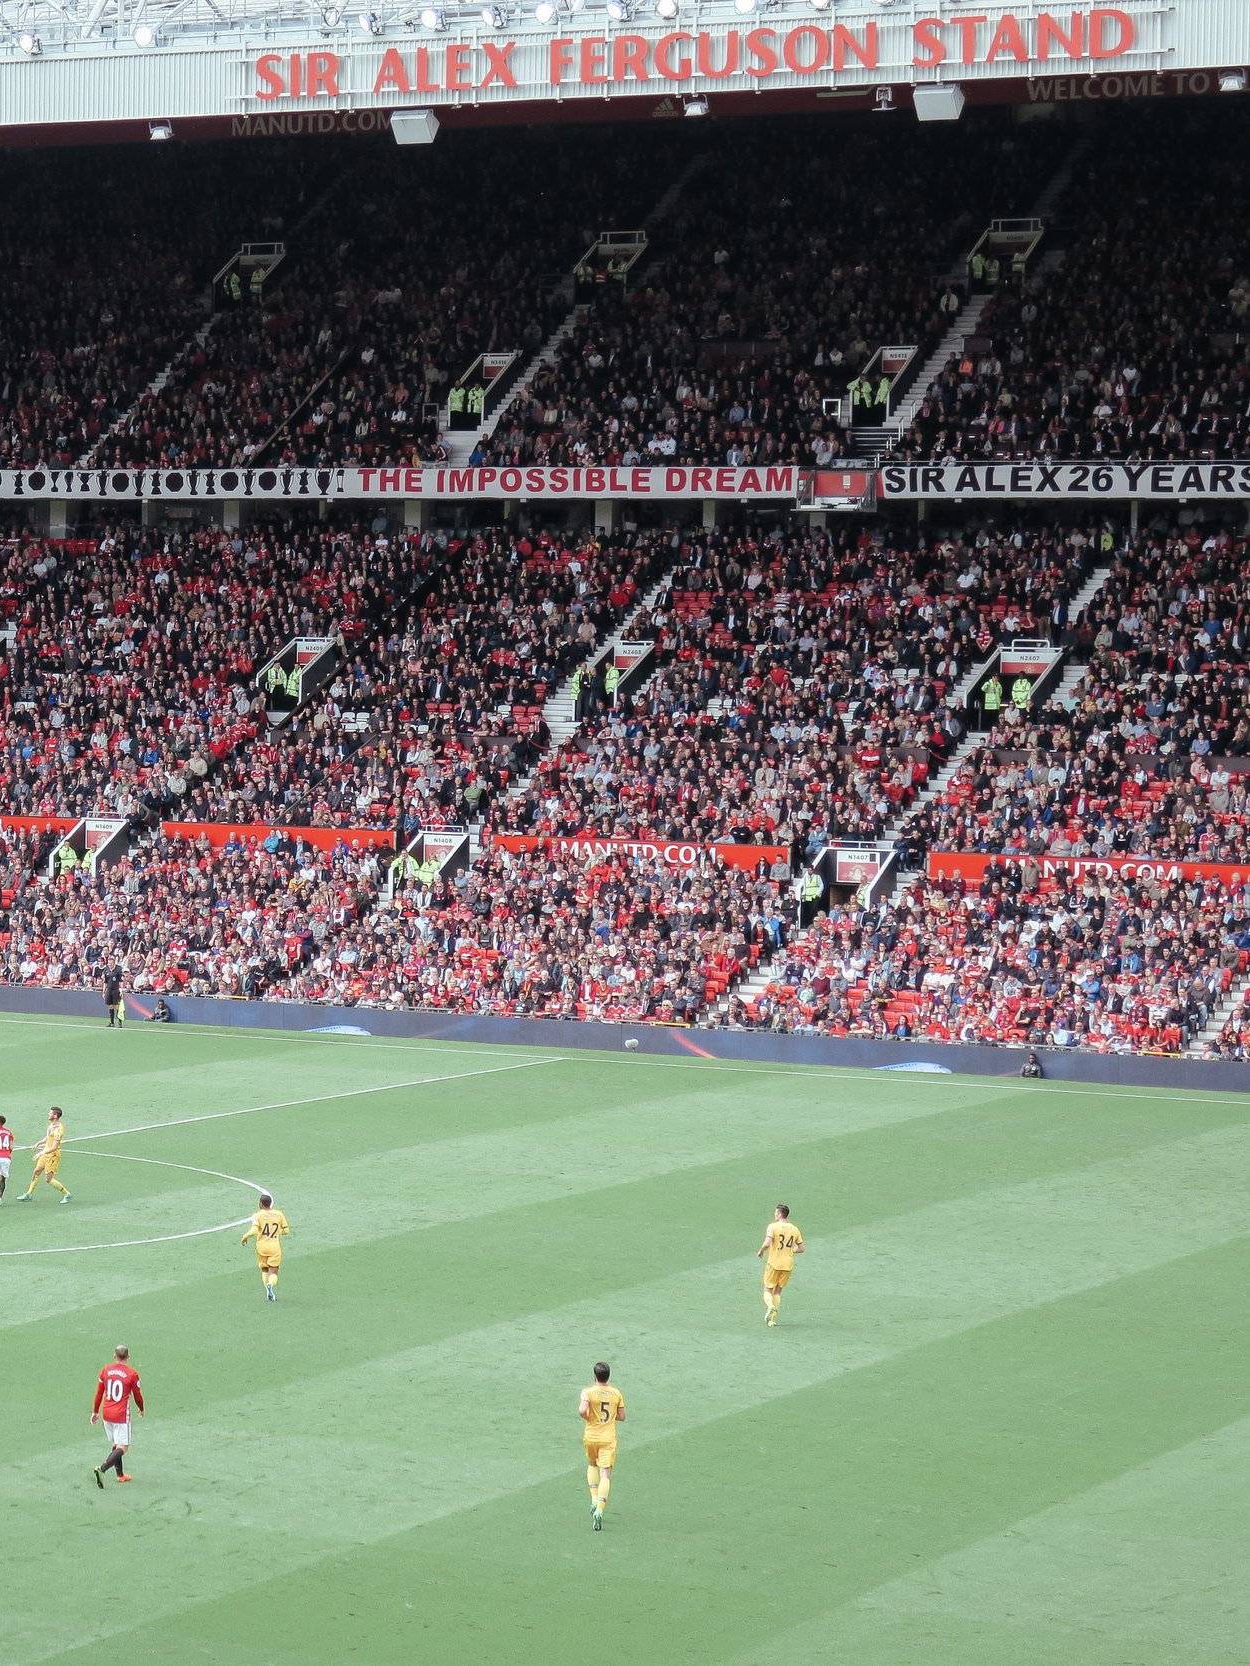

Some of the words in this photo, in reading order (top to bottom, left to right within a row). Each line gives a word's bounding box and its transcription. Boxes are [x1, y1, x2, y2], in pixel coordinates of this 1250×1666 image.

[256, 52, 340, 100] SIR
[373, 41, 517, 94] ALEX
[550, 22, 877, 86] FERGUSON
[912, 9, 1134, 67] STAND
[1027, 74, 1165, 102] WELCOME
[1173, 73, 1211, 95] TO
[232, 111, 390, 137] MANUTD.COM
[357, 468, 424, 493] THE
[436, 467, 651, 493] IMPOSSIBLE
[665, 467, 793, 493] DREAM
[884, 466, 946, 493] SIR
[955, 466, 1061, 493] ALEX
[1067, 466, 1114, 493] 26
[261, 1222, 278, 1239] 42
[777, 1234, 794, 1251] 34
[107, 1369, 128, 1379] ROONEY
[106, 1379, 124, 1402] 10
[600, 1401, 610, 1423] 5
